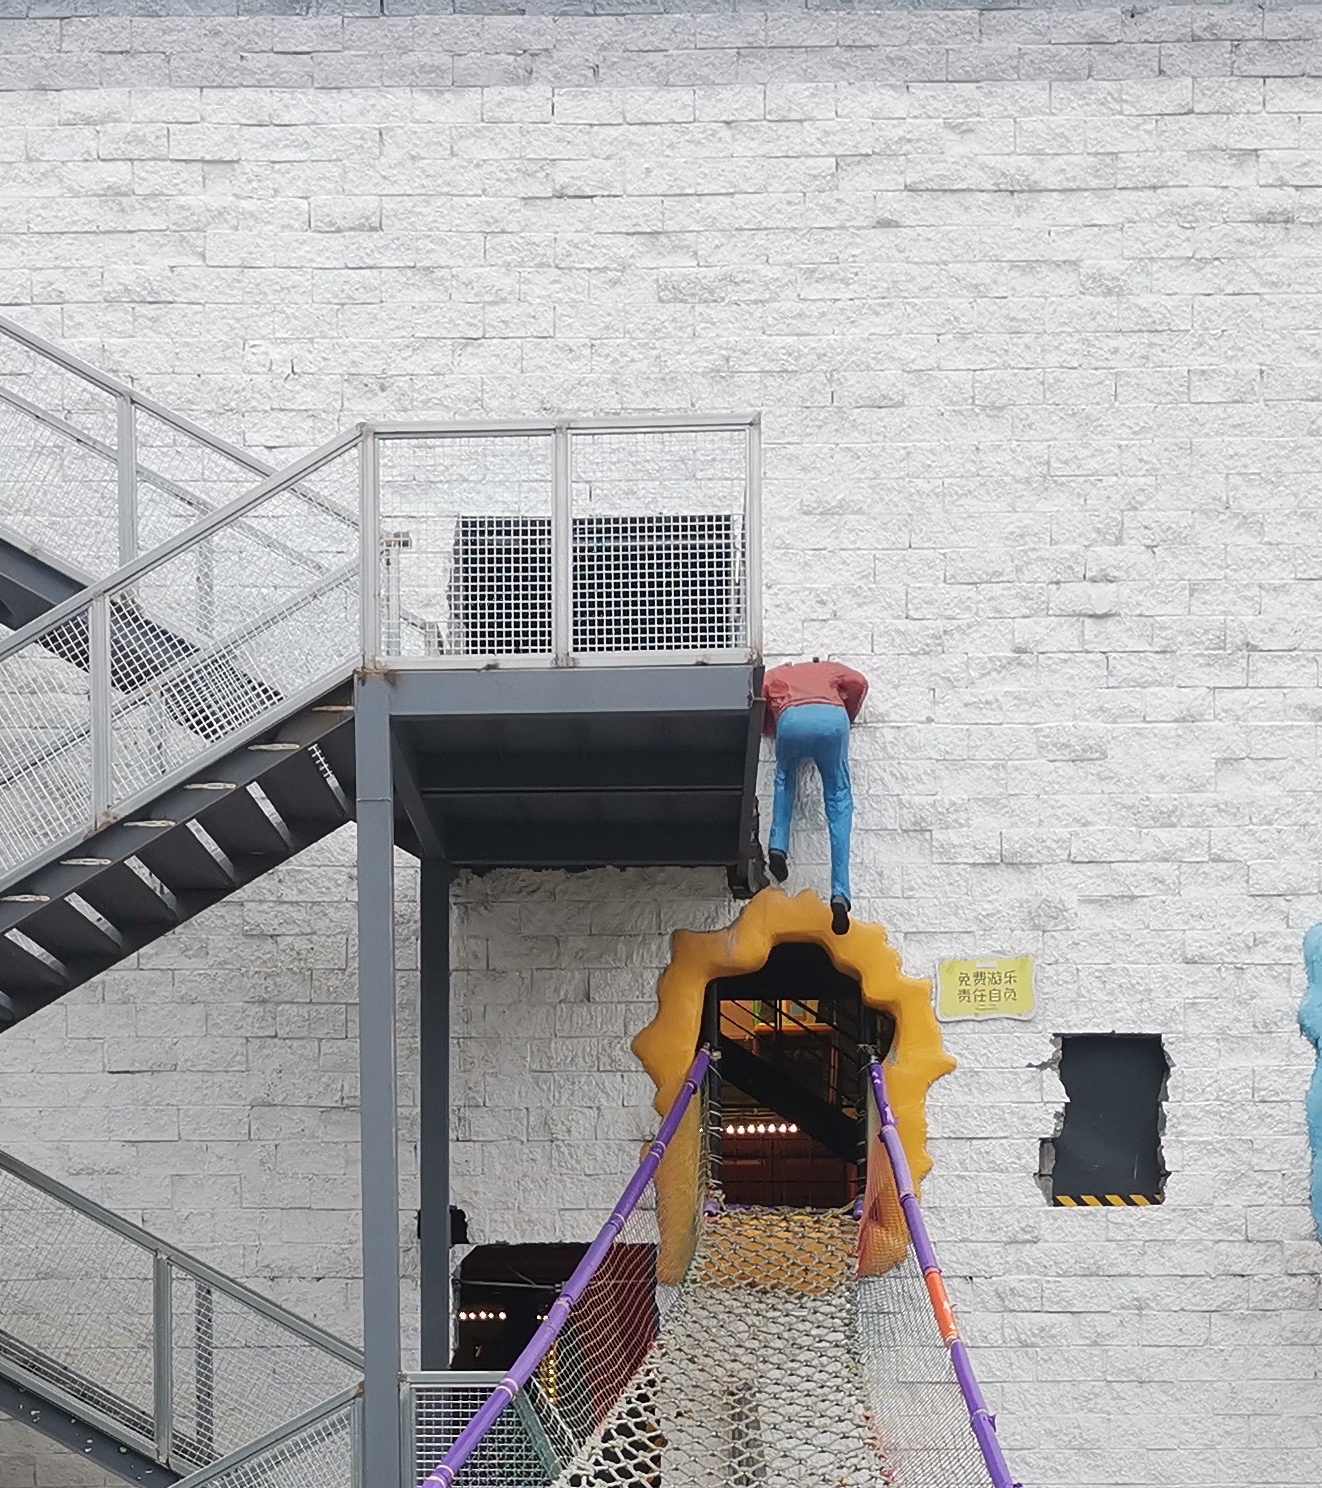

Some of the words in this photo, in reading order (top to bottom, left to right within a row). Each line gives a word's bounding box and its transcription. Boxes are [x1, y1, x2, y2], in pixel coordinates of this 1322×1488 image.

[958, 970, 1018, 986] 免费游乐
[957, 987, 1018, 1003] 责任自负
